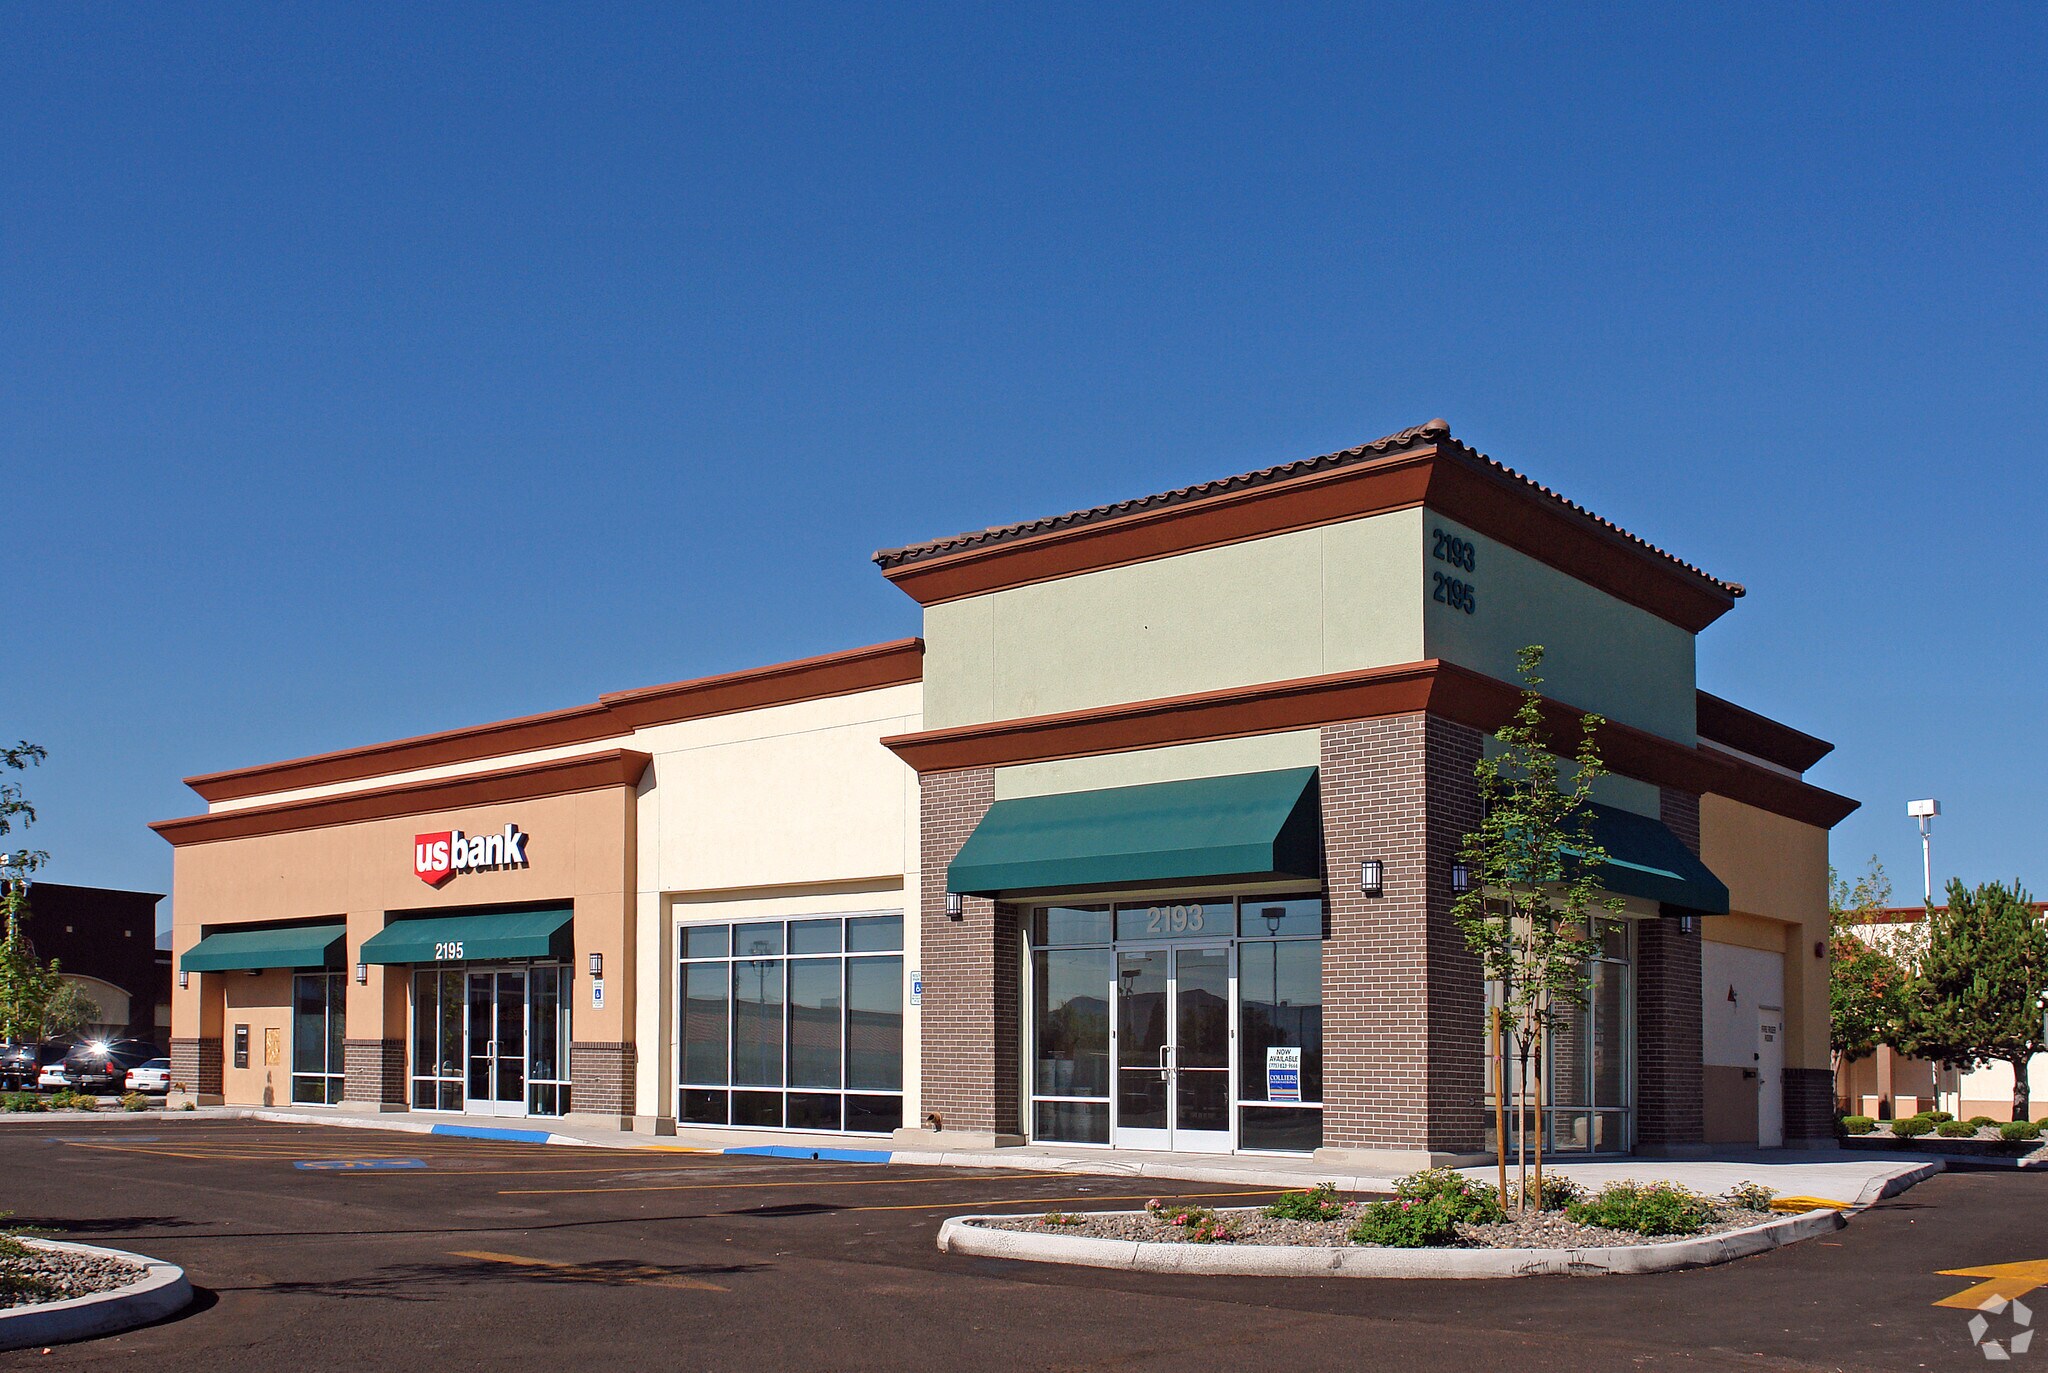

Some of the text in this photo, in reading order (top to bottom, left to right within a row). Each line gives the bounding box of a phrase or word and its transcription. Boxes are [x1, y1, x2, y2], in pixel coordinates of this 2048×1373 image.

[1433, 528, 1476, 573] 2193
[1433, 571, 1476, 615] 2195
[415, 823, 528, 873] usbank
[1146, 904, 1204, 933] 2193
[435, 941, 464, 960] 2195
